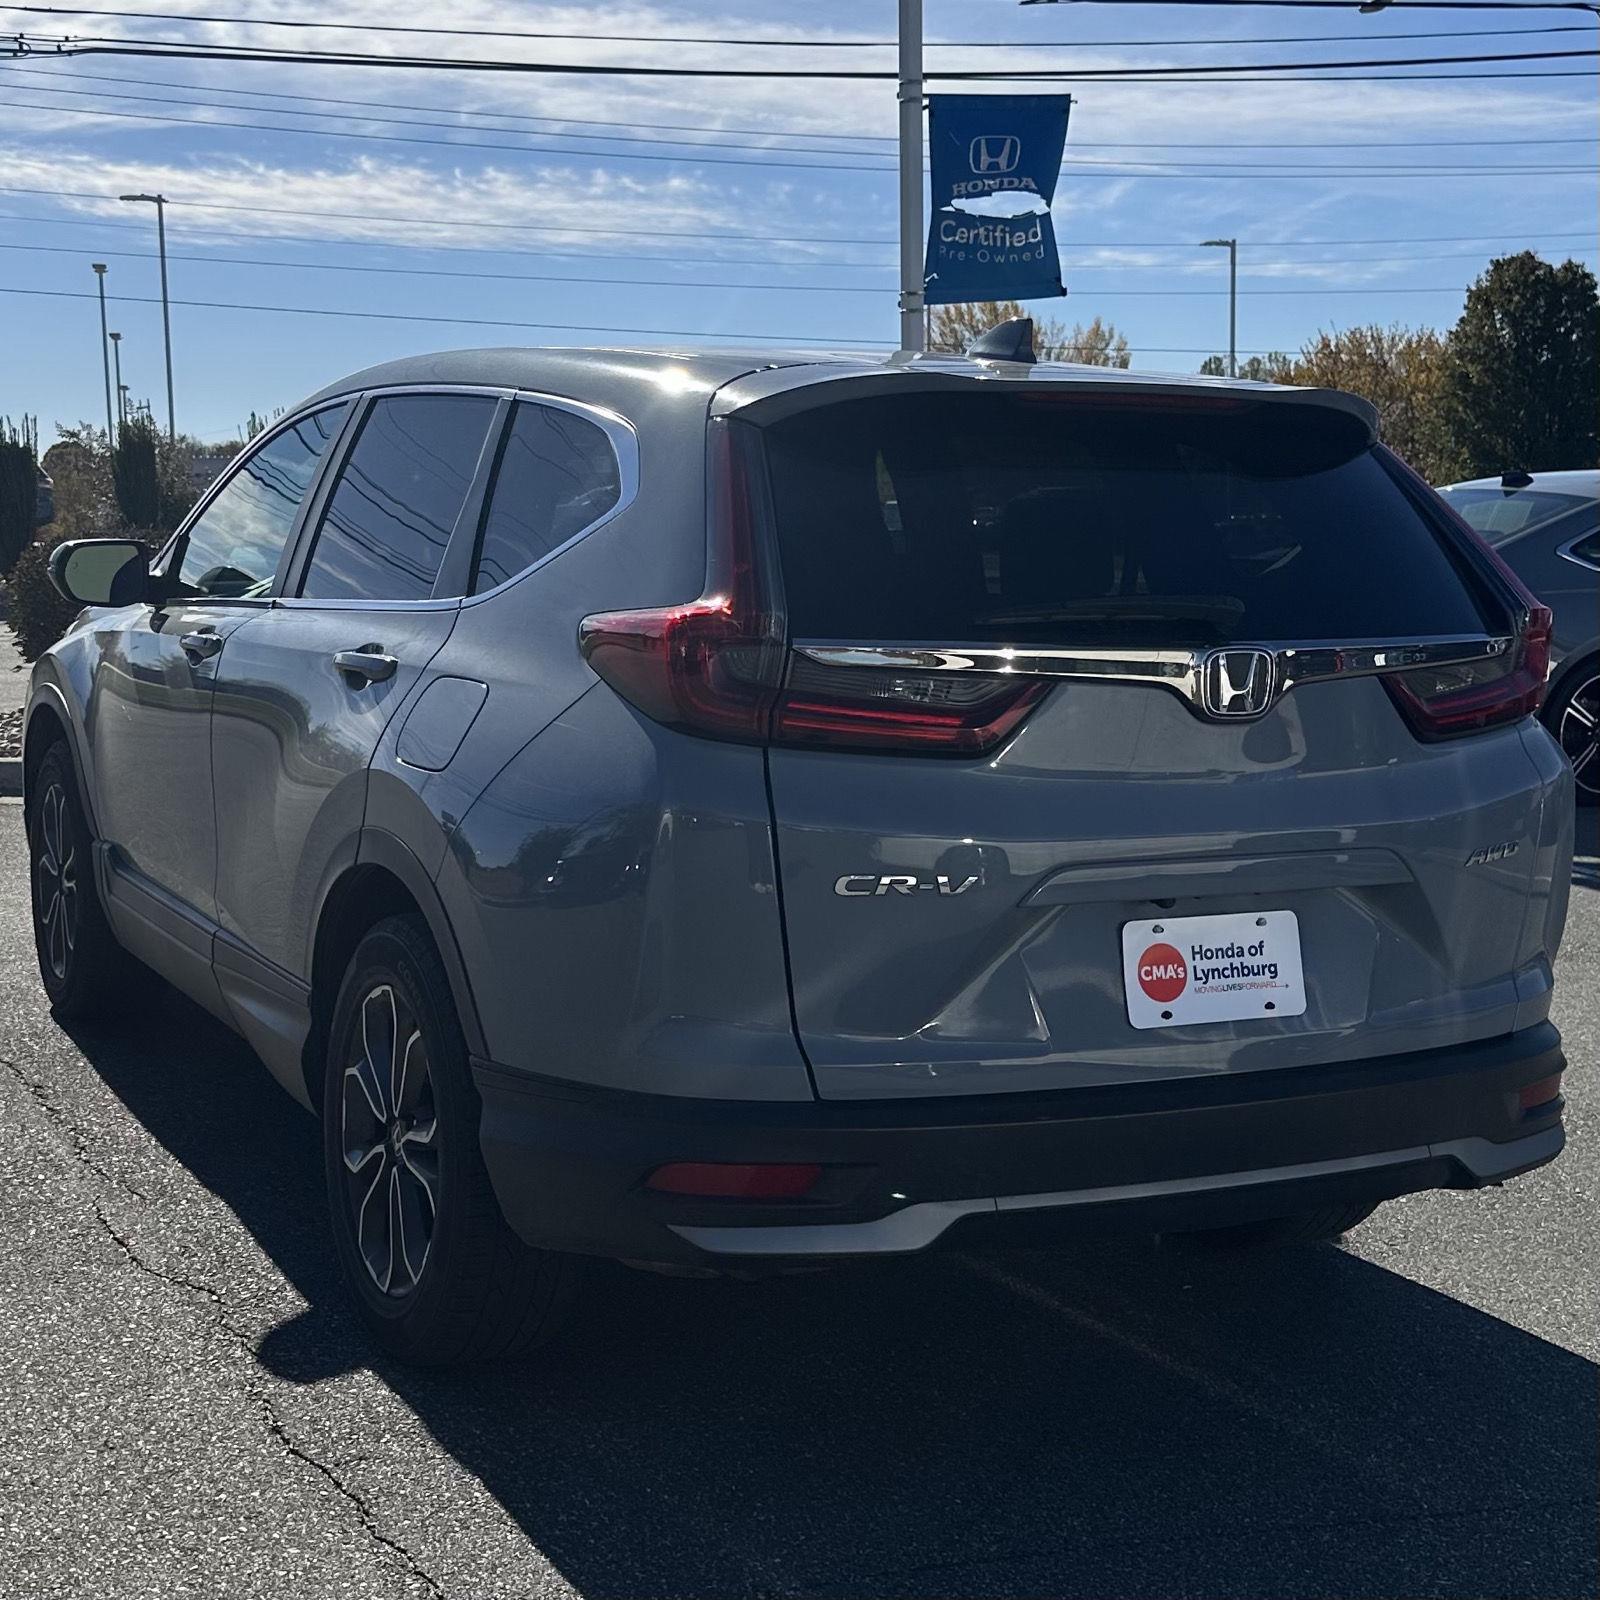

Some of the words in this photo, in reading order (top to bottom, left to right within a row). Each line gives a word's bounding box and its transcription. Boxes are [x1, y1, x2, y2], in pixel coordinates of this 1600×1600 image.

[952, 177, 1038, 196] HONDA
[940, 217, 1043, 248] Certified
[834, 873, 979, 897] CR-V
[1190, 942, 1245, 962] Honda
[1247, 940, 1265, 957] of
[1140, 963, 1186, 982] CMA's
[1193, 961, 1279, 985] Lynchburg
